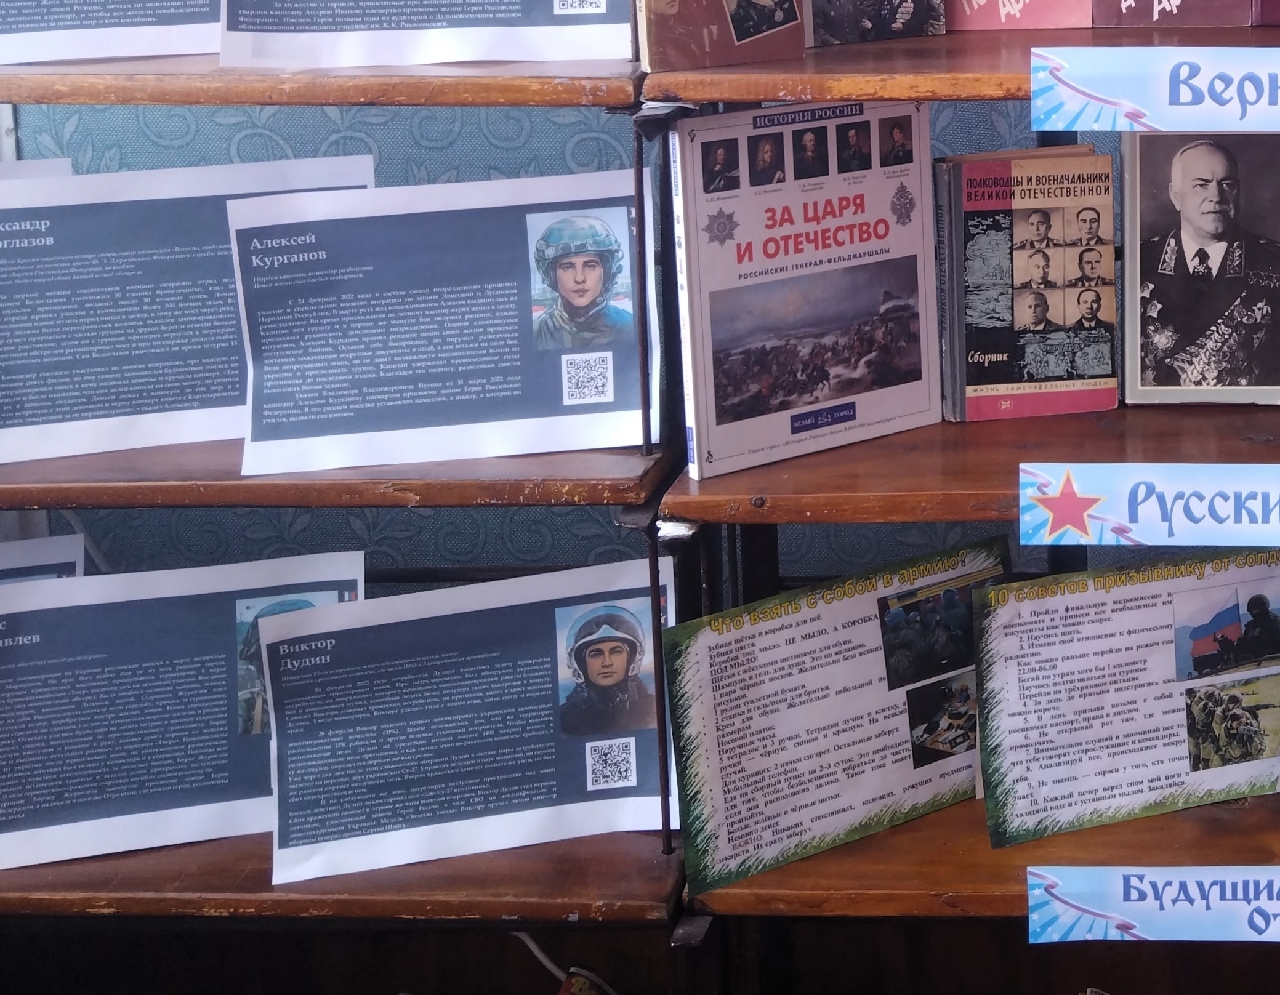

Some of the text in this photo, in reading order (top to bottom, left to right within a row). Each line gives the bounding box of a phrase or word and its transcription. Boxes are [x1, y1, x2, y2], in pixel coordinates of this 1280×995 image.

[756, 104, 860, 127] ИСТОРИЯ РОССИИ
[966, 171, 1110, 189] ПОЛКОВОДЦЫ И ВОЕНАЧАЛЬНИКИ
[966, 182, 1110, 202] ВЕЛИКОЙ ОТЕЧЕСТВЕННОЙ
[764, 193, 866, 230] ЗА ЦАРЯ
[250, 233, 317, 251] Алексей
[735, 218, 890, 265] И ОТЕЧЕСТВО
[251, 248, 327, 269] Курганов
[738, 265, 789, 280] РОССИЙСКИЕ
[967, 350, 1010, 367] Сборник
[987, 589, 1008, 607] 10
[1015, 579, 1088, 603] советов
[1093, 559, 1206, 593] призывнику
[1211, 556, 1230, 573] от
[710, 549, 968, 636] Что взять с собой в армию?
[279, 637, 336, 655] Виктор
[280, 653, 331, 671] Дудин
